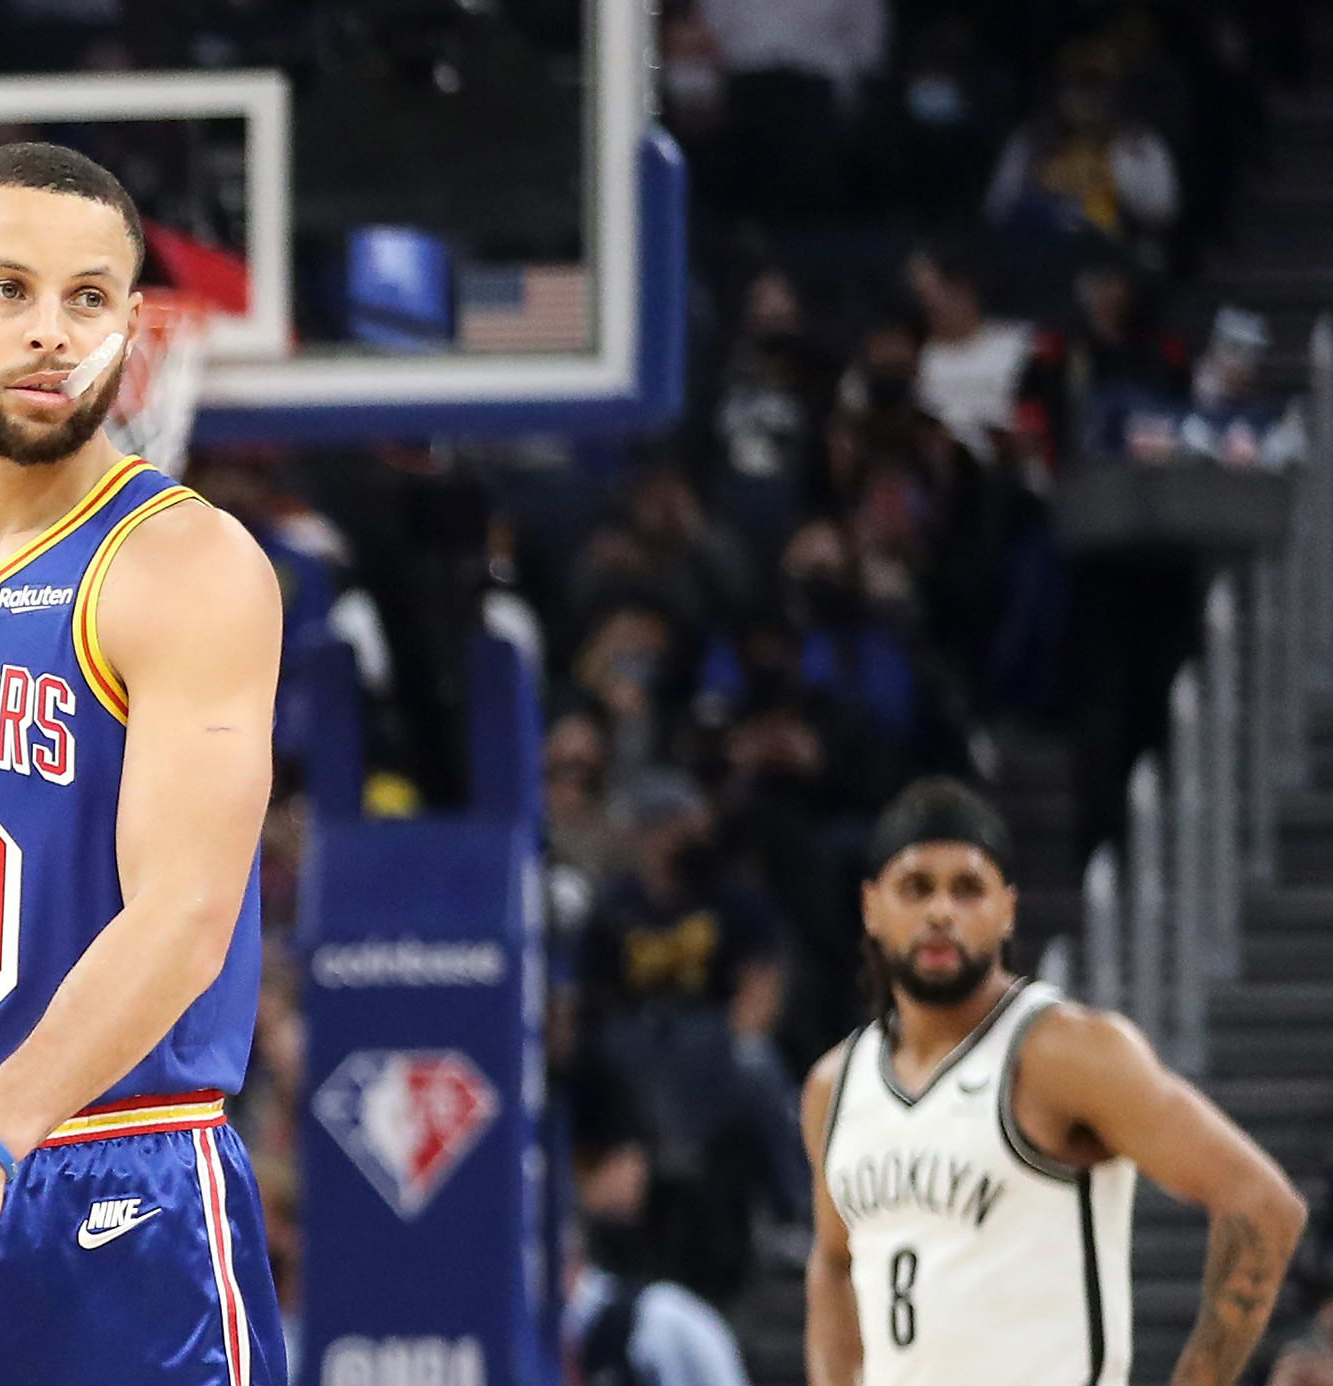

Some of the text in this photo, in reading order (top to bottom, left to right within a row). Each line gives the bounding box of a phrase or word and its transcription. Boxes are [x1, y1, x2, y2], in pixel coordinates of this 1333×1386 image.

[87, 1198, 142, 1230] NIKE
[835, 1150, 1004, 1228] ROOKLYN
[891, 1248, 918, 1349] 8
